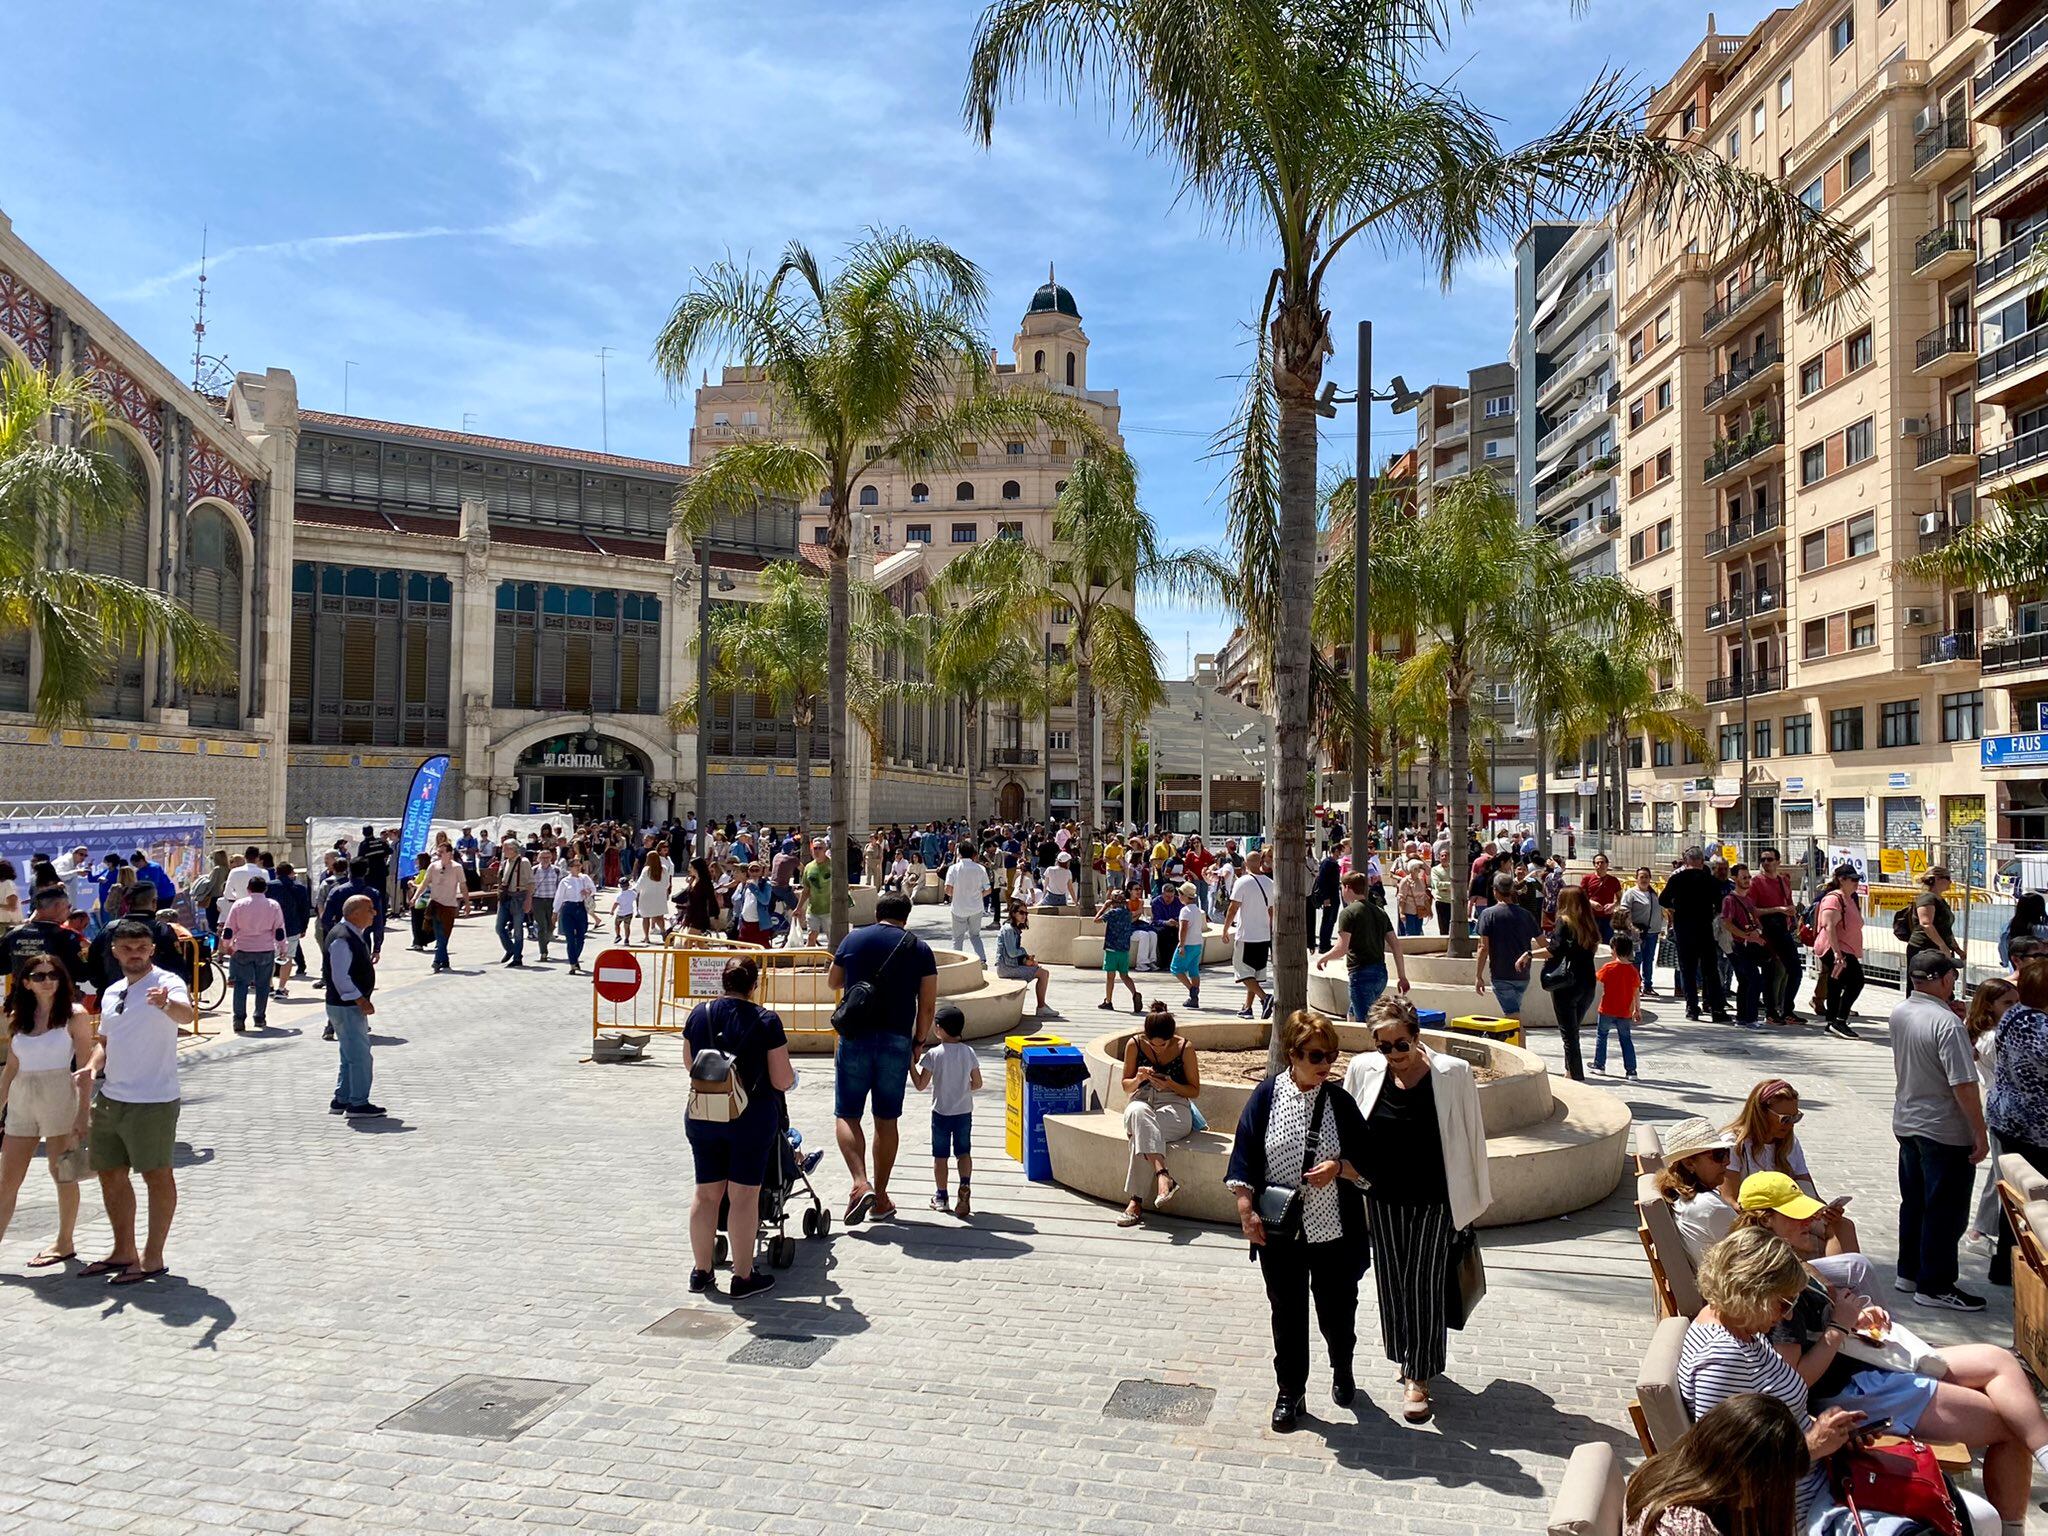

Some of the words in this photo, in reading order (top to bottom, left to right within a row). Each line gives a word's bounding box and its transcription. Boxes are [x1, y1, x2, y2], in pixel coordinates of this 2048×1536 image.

[2011, 736, 2041, 752] FAUS
[557, 753, 605, 768] CENTRAL
[404, 799, 421, 841] Paella
[401, 842, 412, 859] La
